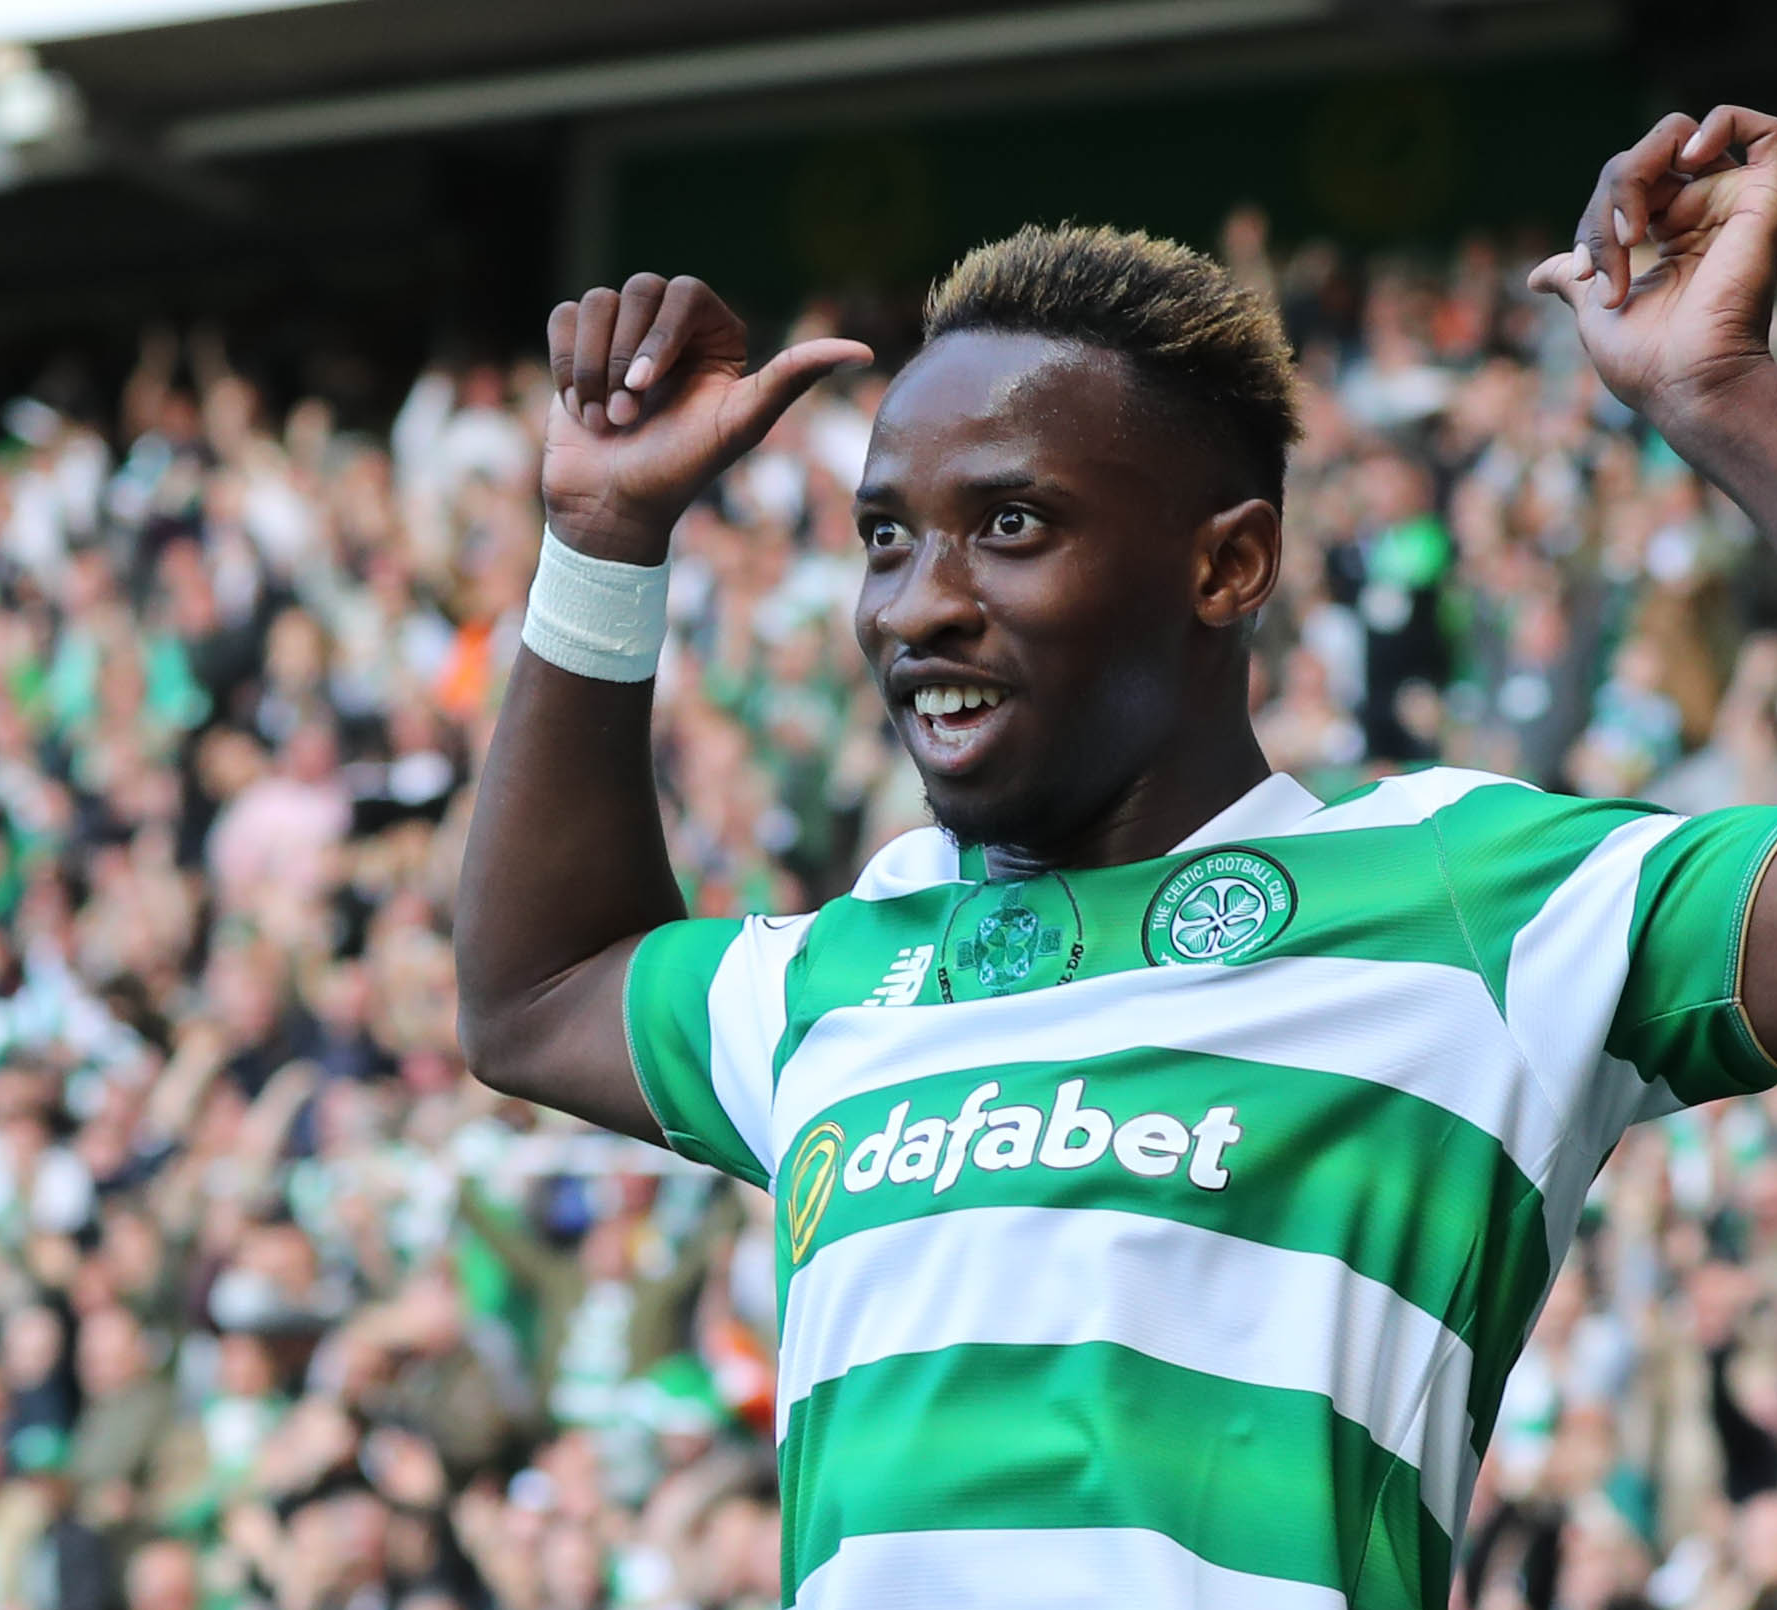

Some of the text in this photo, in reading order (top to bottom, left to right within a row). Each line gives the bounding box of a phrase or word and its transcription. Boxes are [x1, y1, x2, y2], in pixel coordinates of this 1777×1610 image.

[1153, 857, 1287, 931] THE CELTIC FOOTBALL CLUB
[842, 1077, 1242, 1194] dafabet
